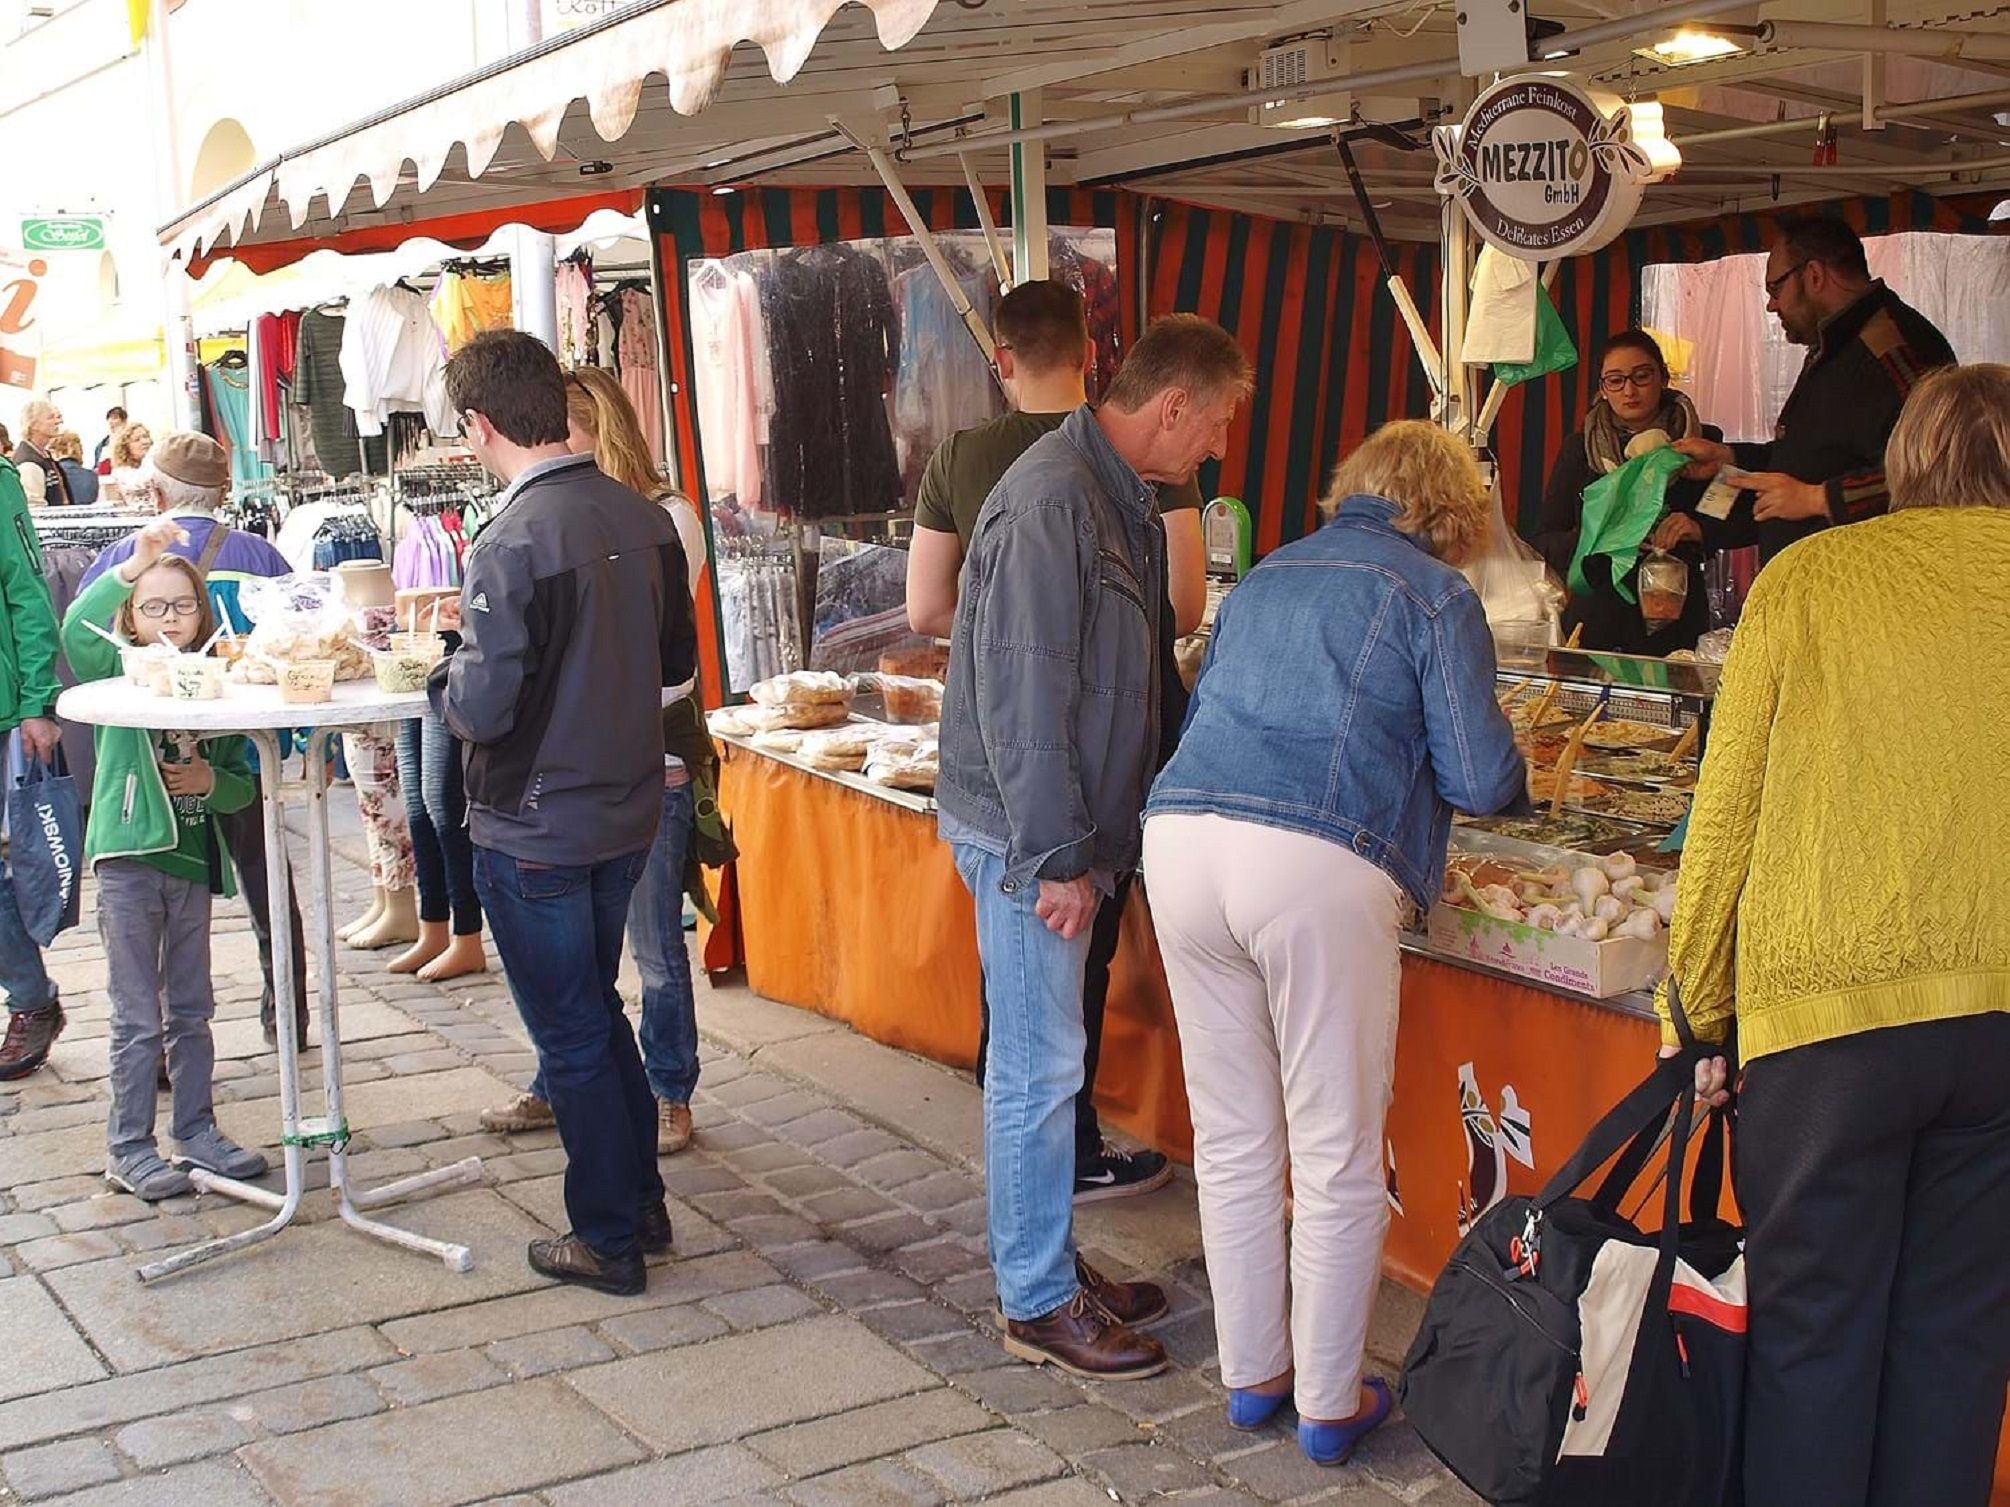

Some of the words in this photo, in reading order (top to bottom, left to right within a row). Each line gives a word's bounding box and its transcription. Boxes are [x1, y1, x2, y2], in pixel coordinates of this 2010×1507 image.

[1467, 93, 1526, 151] Mediterrane
[1528, 86, 1577, 120] Feinkost
[1482, 139, 1589, 183] MEZZITO
[1544, 183, 1580, 204] GmbH
[1496, 217, 1549, 246] Delikates
[1551, 217, 1585, 243] Essen
